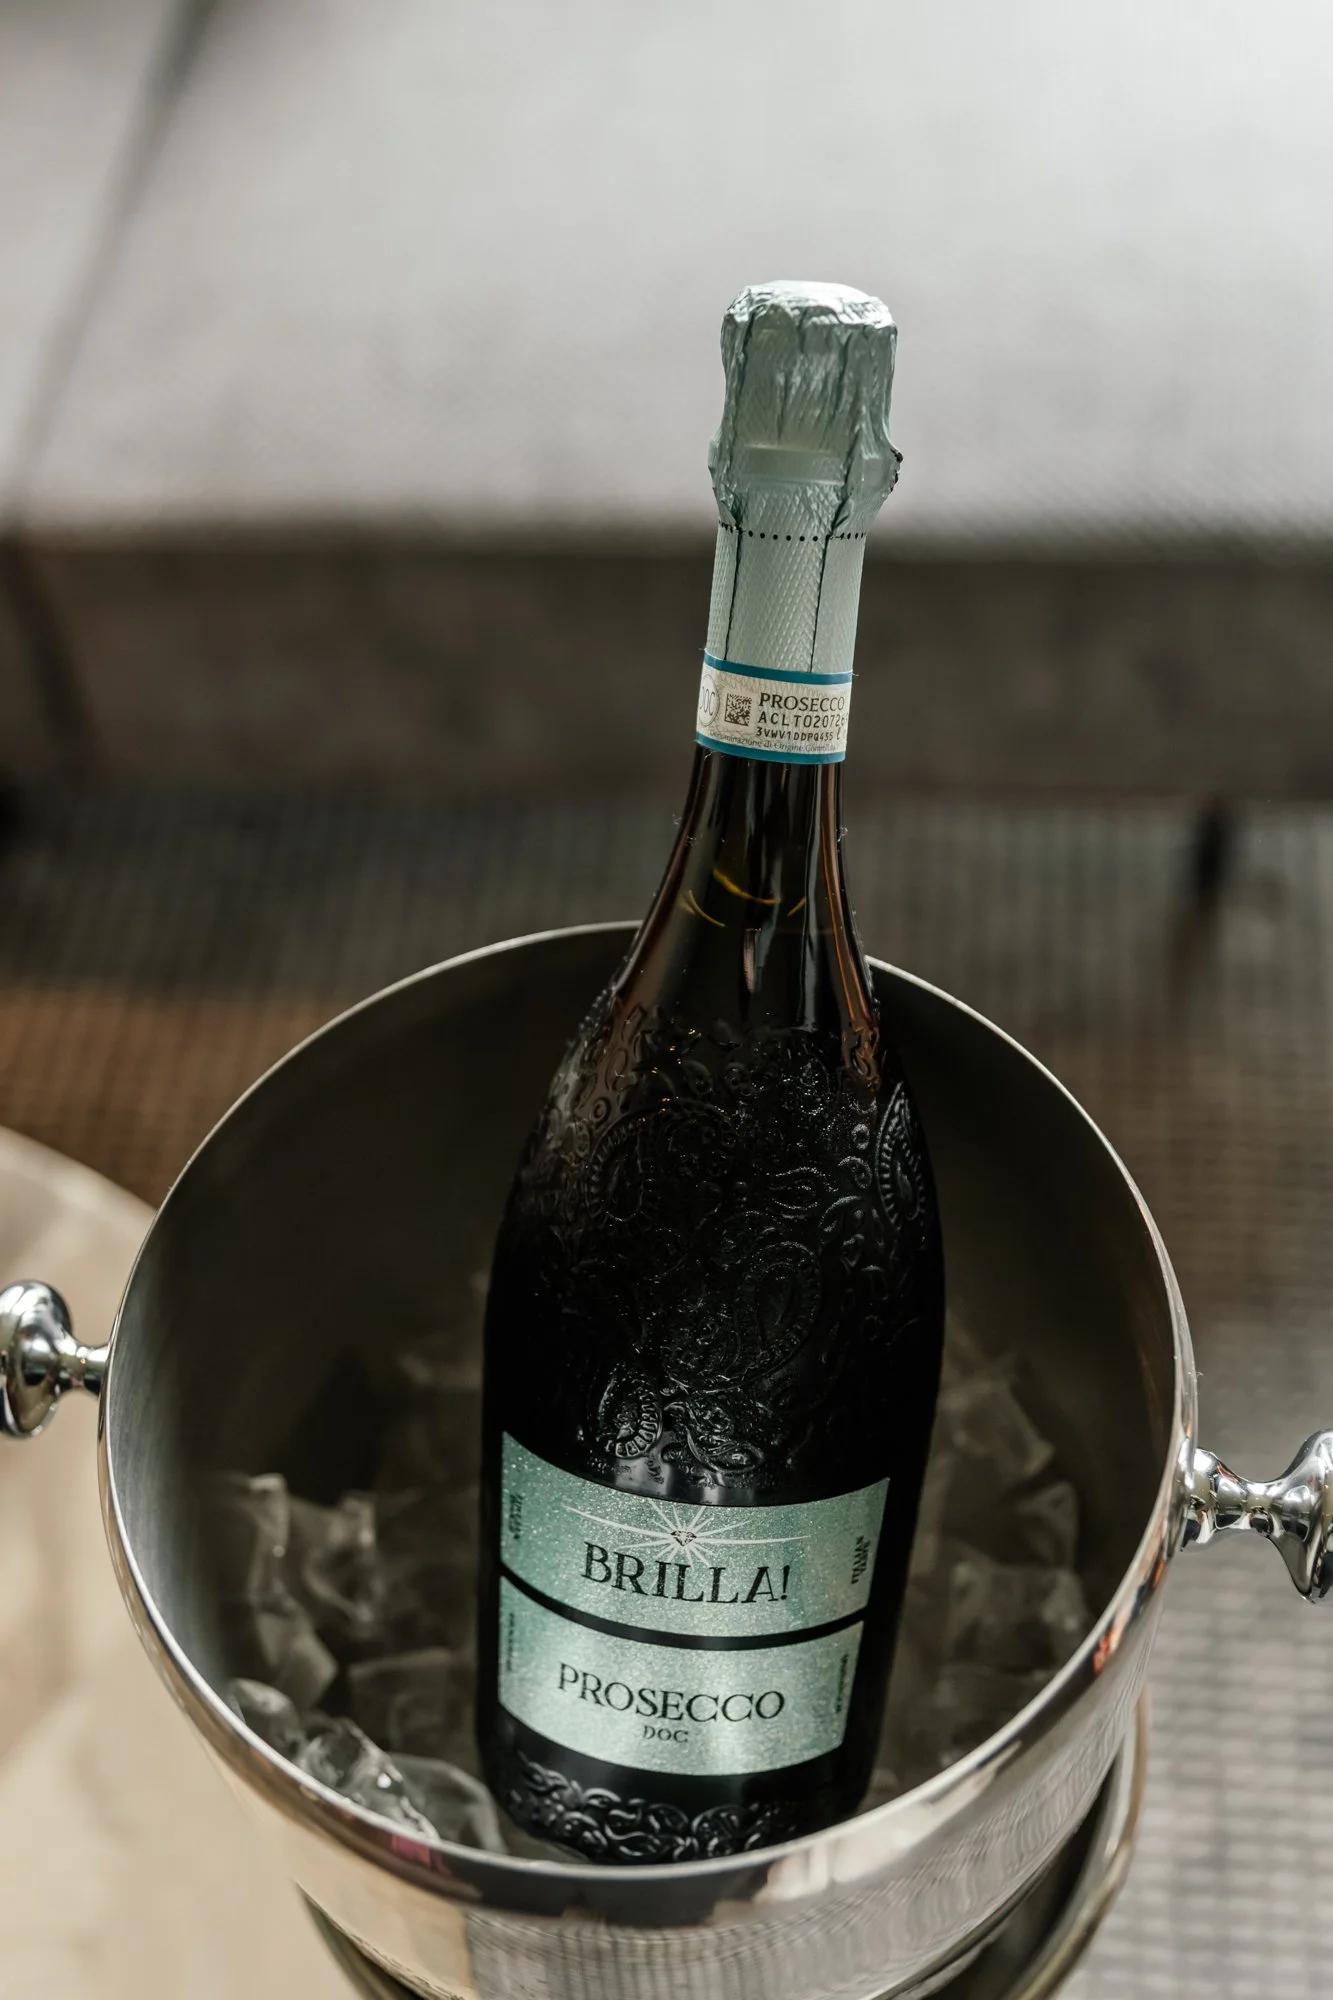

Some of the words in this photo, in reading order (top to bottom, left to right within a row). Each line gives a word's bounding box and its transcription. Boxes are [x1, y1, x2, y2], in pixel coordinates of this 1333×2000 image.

[759, 692, 845, 713] PROSECCO
[580, 1541, 791, 1604] BRILLA!
[557, 1662, 786, 1723] PROSECCO
[642, 1724, 690, 1744] DOC
